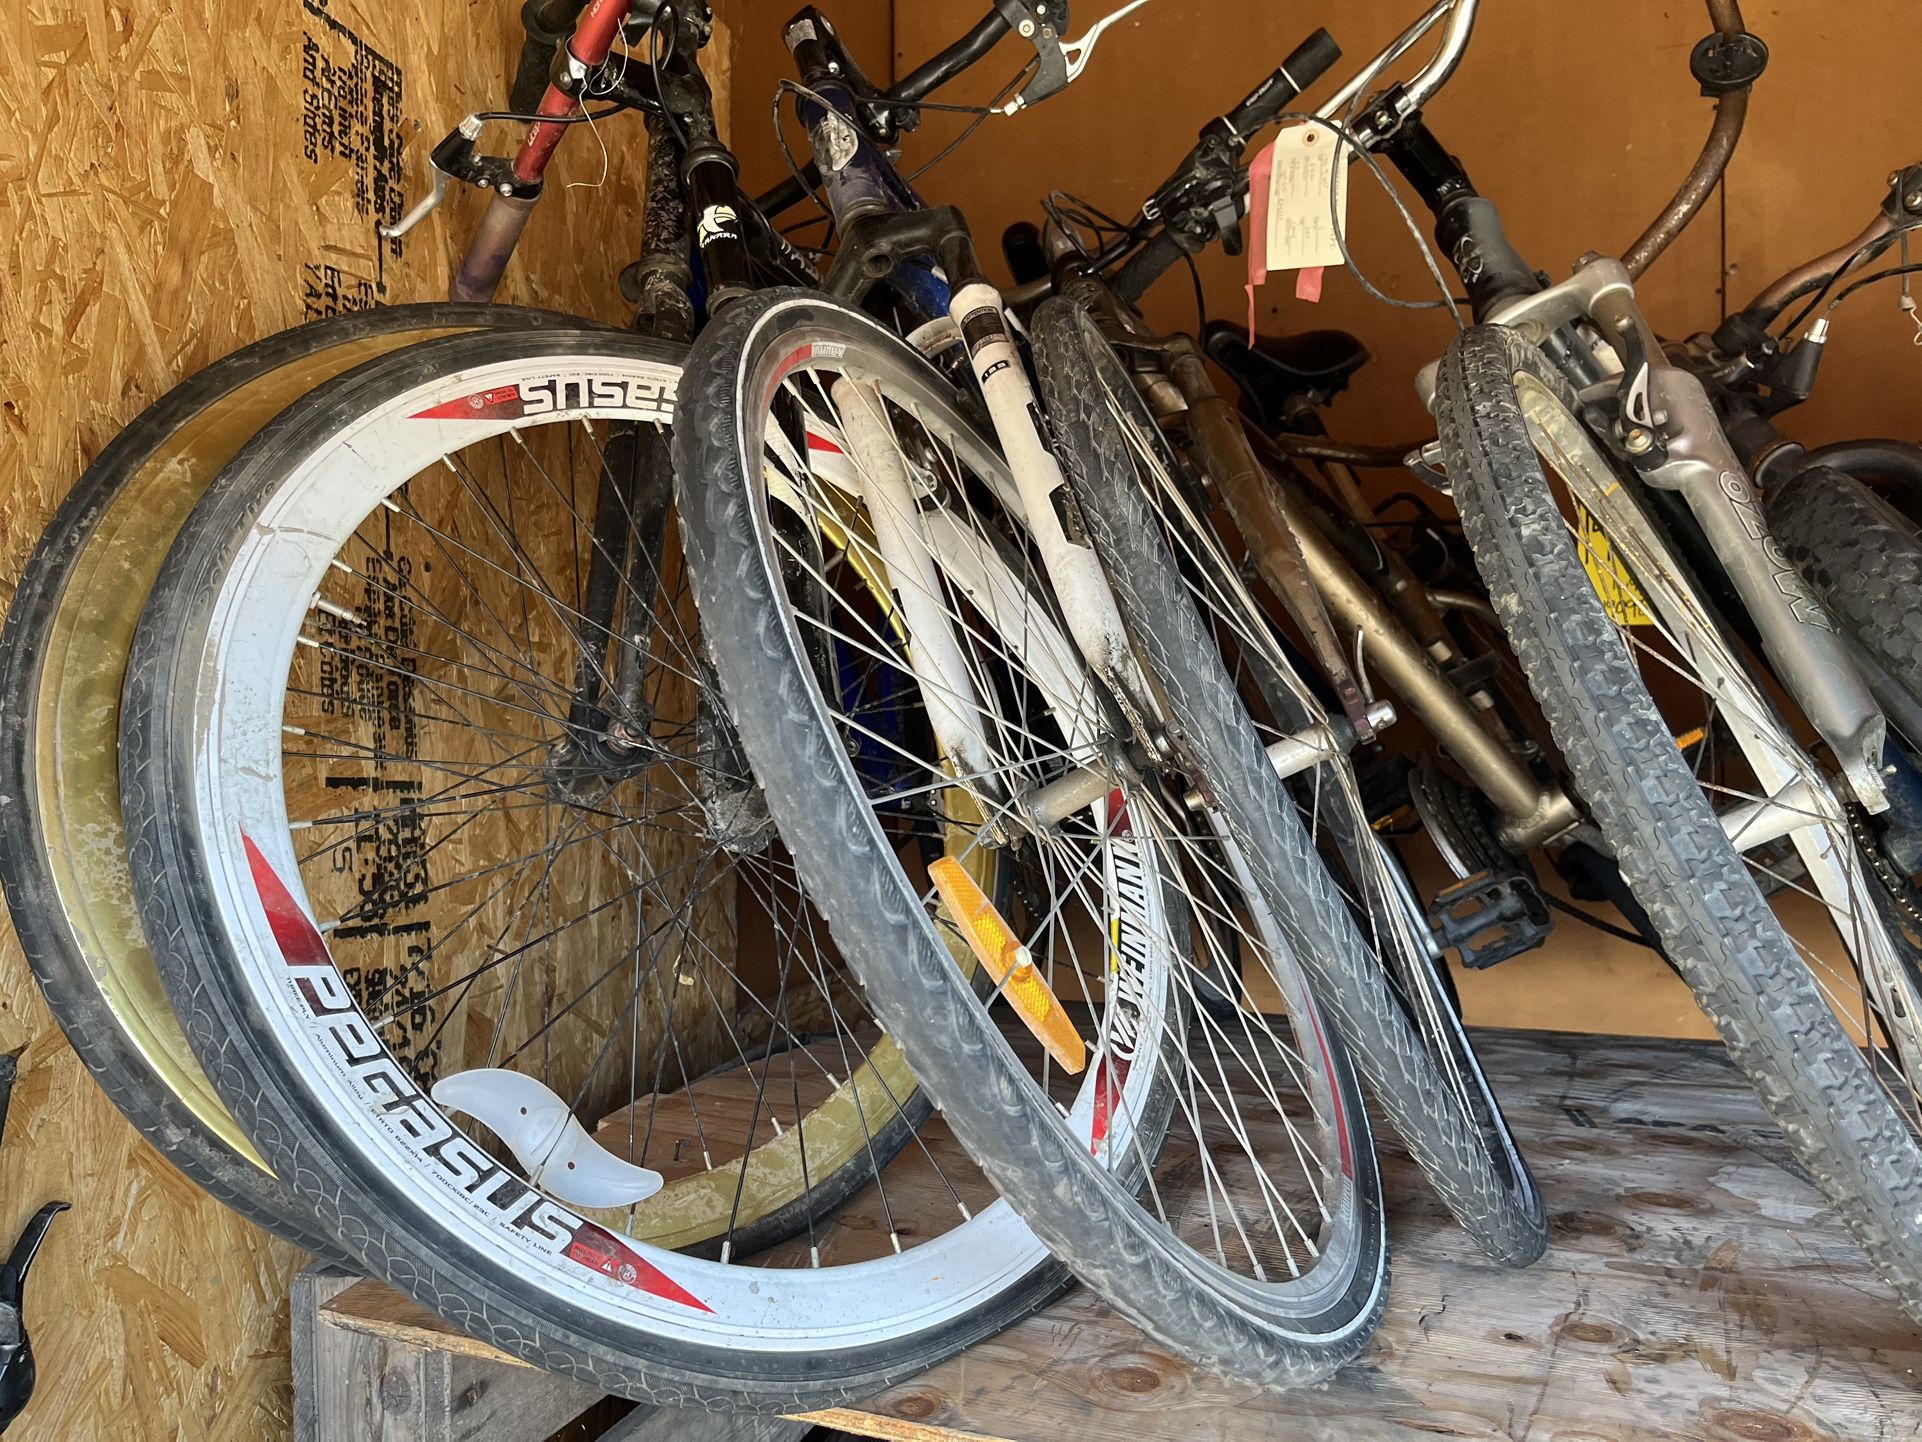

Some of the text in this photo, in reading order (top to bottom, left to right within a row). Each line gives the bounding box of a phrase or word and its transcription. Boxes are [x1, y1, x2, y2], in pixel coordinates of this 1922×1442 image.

[303, 31, 320, 165] And Sides
[1111, 836, 1146, 1005] WEINMANN
[315, 1032, 348, 1078] Aluminum
[347, 1078, 365, 1100] Alloy
[498, 1220, 531, 1243] SAFETY
[532, 1241, 554, 1257] LINE
